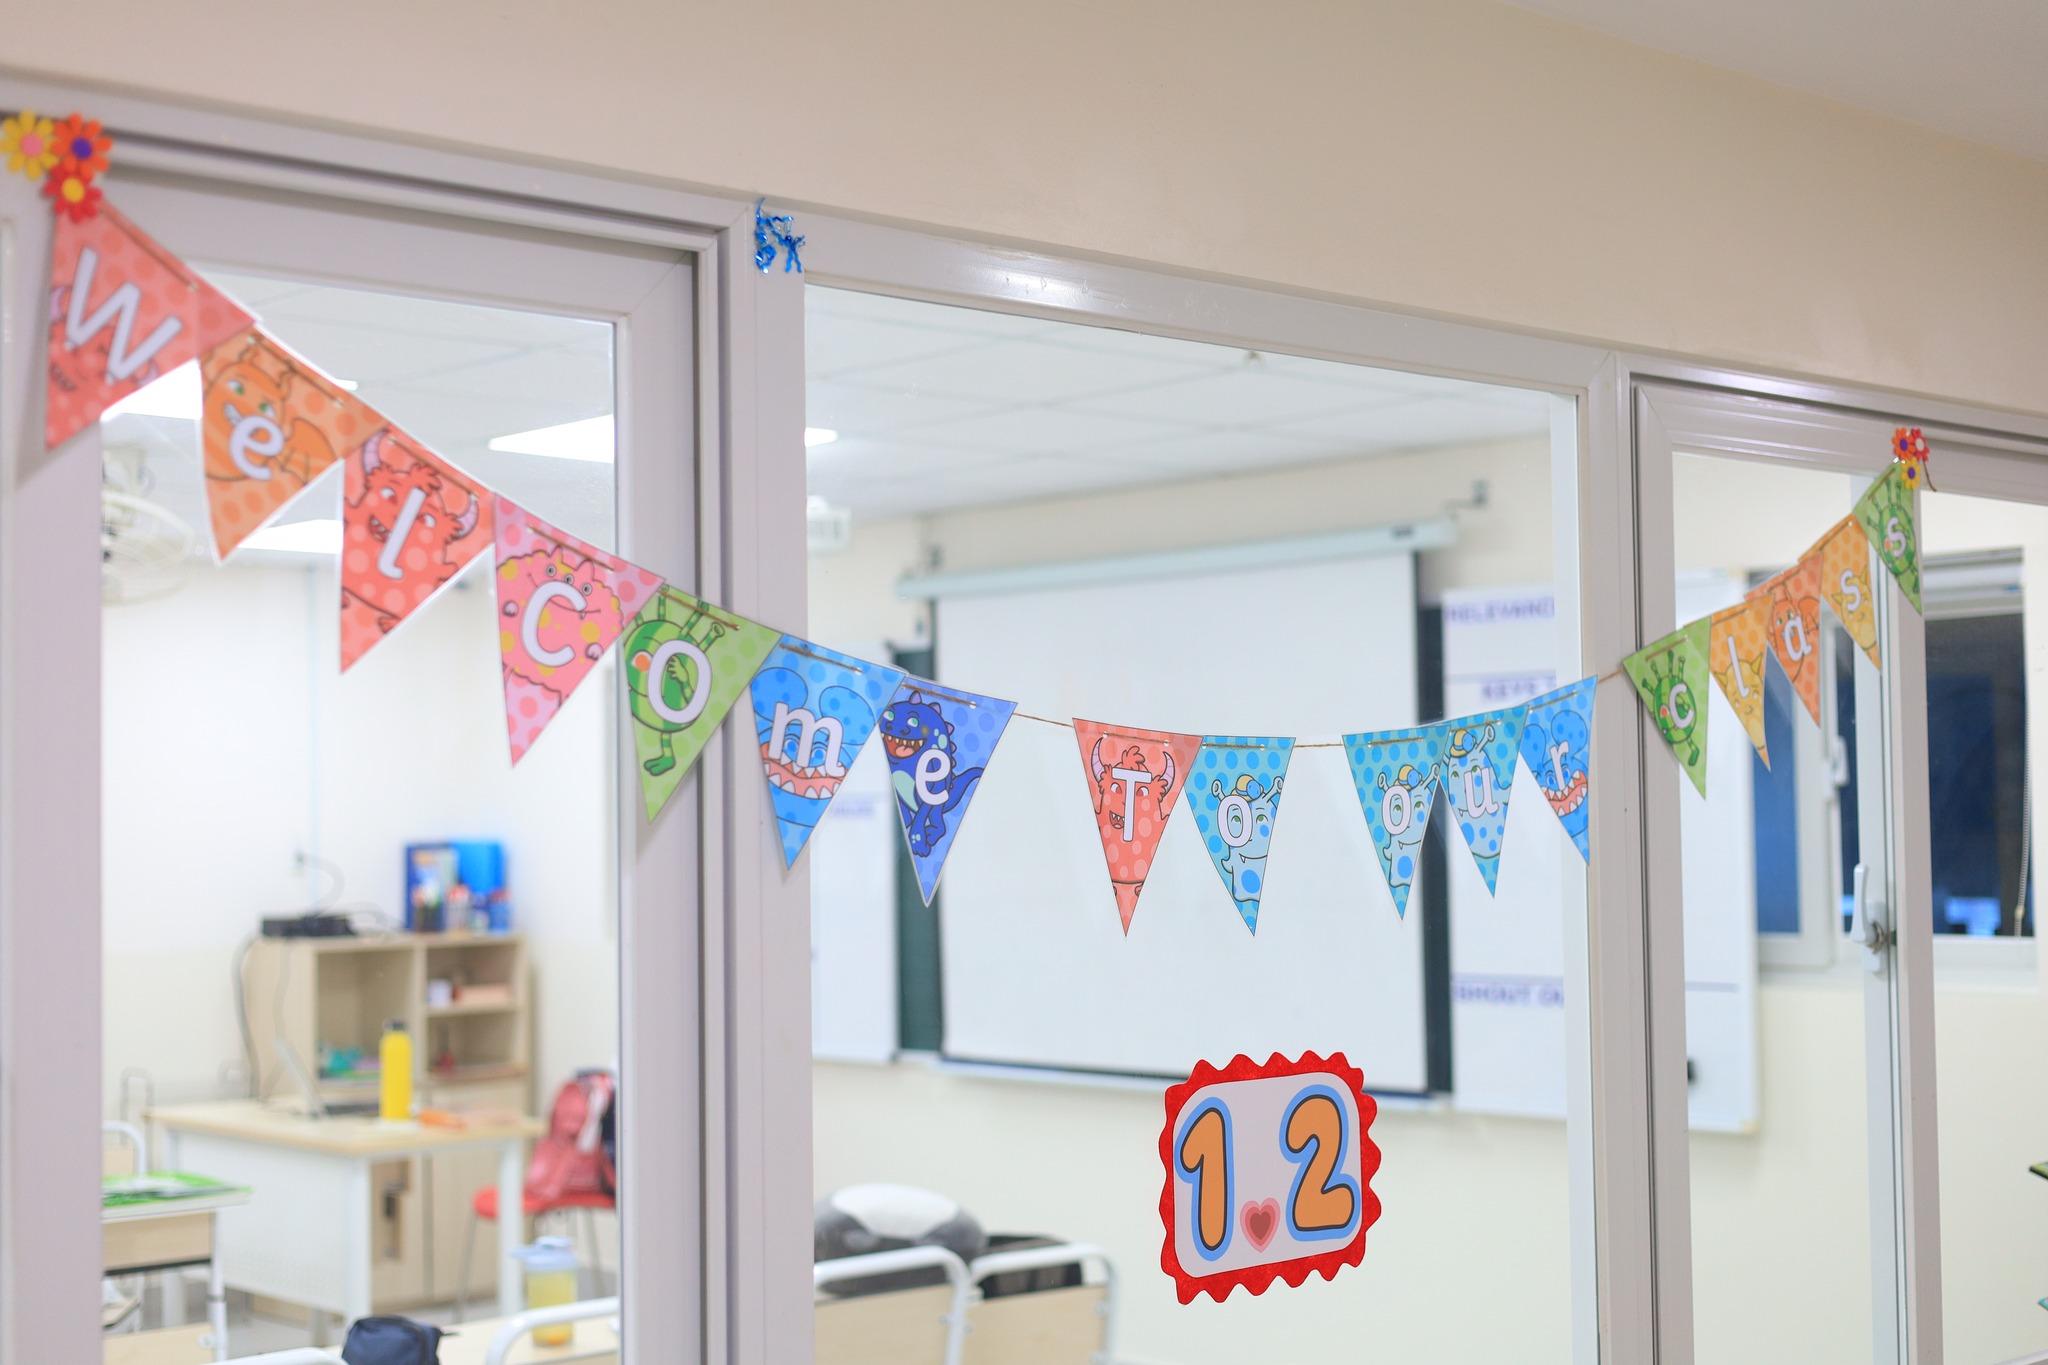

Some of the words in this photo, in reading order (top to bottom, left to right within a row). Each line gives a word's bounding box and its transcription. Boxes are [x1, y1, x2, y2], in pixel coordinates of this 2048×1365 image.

[65, 247, 951, 806] Welcome
[1111, 767, 1255, 848] To
[1381, 740, 1570, 836] our
[1668, 516, 1907, 730] class
